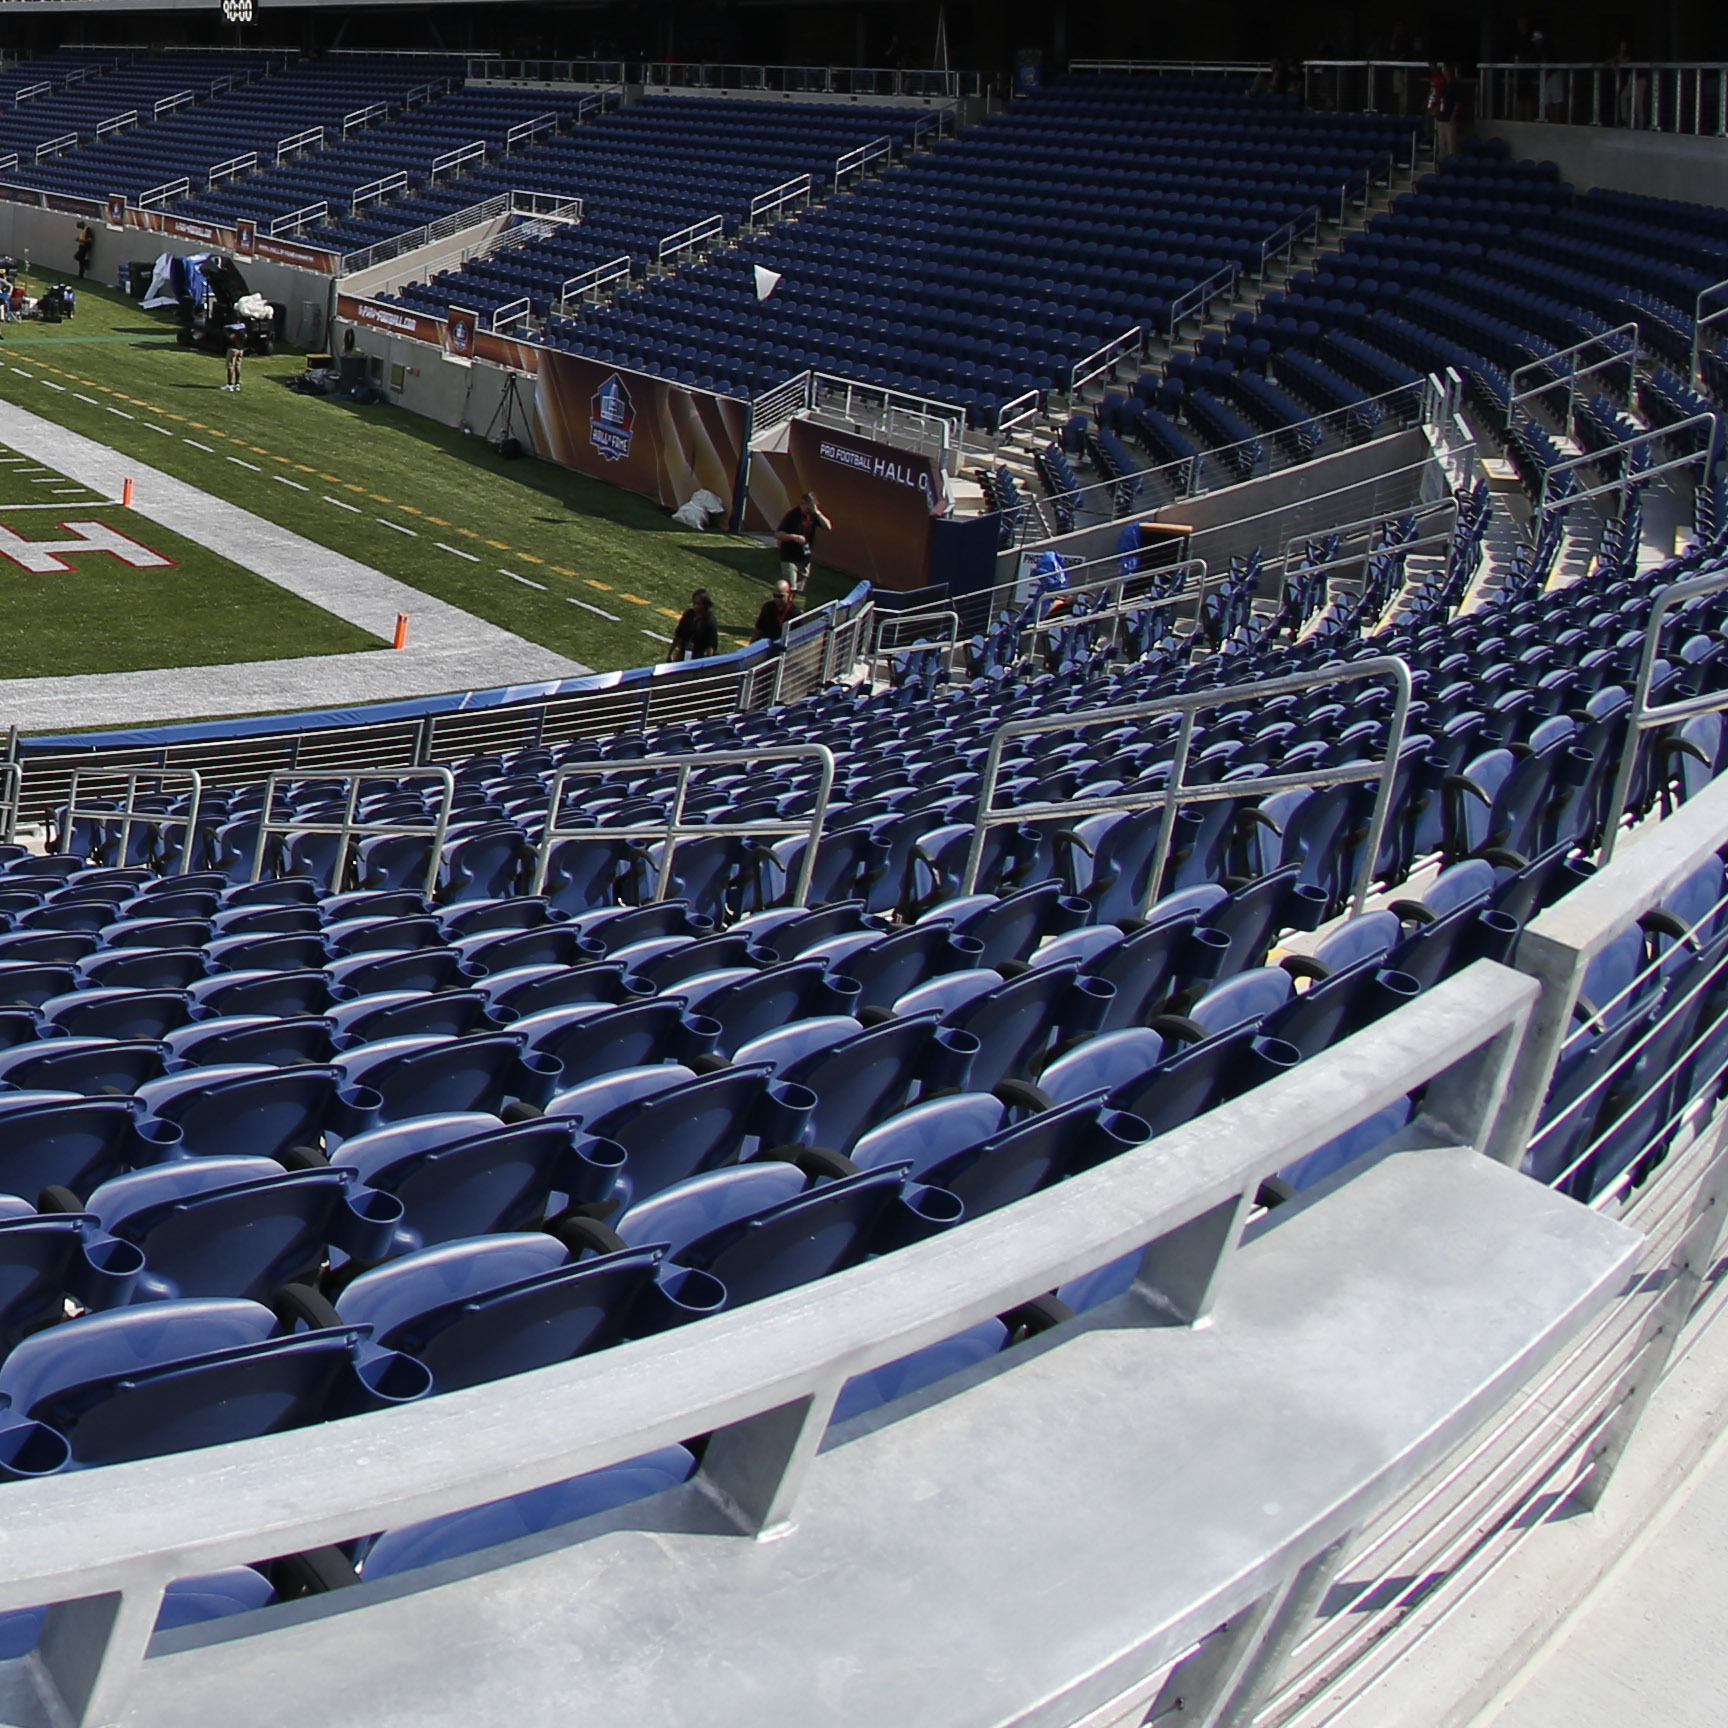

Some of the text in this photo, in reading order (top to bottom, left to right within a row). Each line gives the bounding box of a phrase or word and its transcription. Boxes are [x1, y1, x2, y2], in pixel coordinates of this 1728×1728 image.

[222, 0, 253, 22] 90:00
[820, 443, 835, 458] PRO
[836, 448, 872, 470] FOOTBALL
[873, 458, 915, 487] HALL
